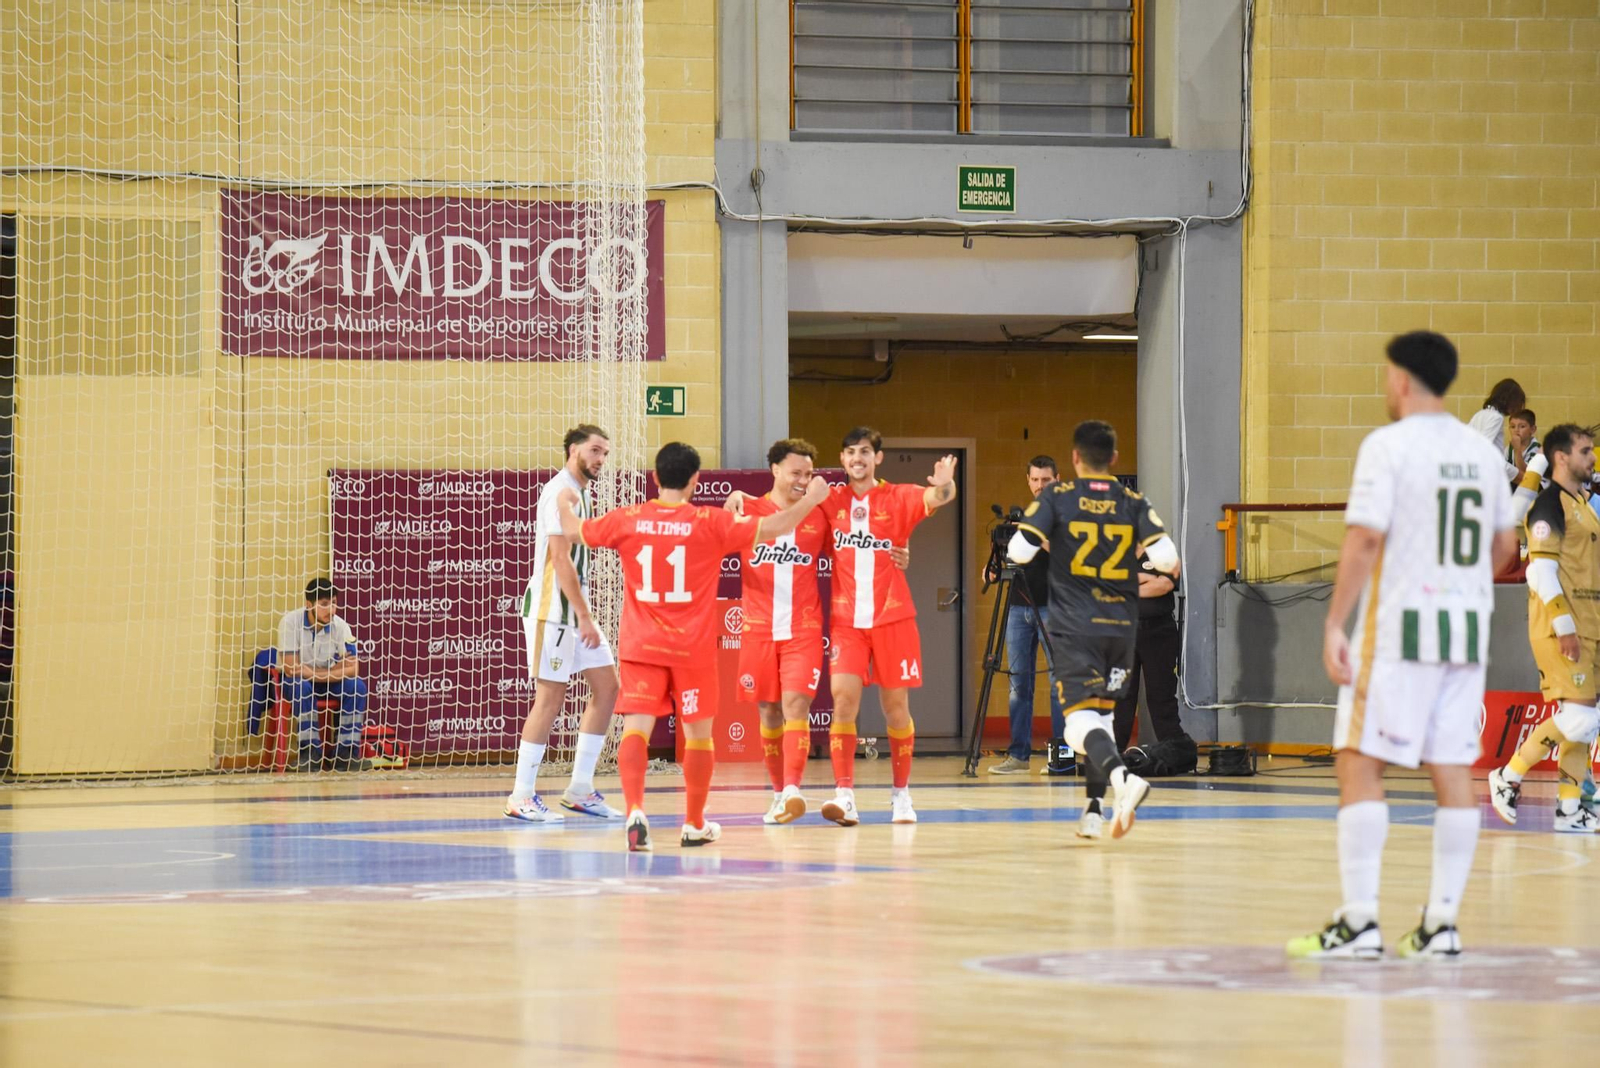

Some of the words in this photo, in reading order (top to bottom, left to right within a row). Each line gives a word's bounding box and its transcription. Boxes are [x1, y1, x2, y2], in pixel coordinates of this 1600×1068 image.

[967, 172, 994, 187] SALIDA
[996, 173, 1006, 188] DE
[962, 190, 1011, 206] EMERGENCIA
[340, 235, 647, 300] IMDECO
[243, 310, 328, 332] Instituto
[333, 313, 431, 337] Municipal
[436, 314, 462, 334] de
[467, 316, 558, 339] Deportes
[436, 481, 495, 495] IMDECO
[393, 520, 452, 534] IMDECO
[635, 519, 692, 537] WALTINHO
[1437, 487, 1483, 567] 16
[751, 541, 811, 565] Jimbee
[1068, 521, 1134, 580] 22
[445, 559, 504, 573] IMDECO
[635, 545, 693, 603] 11
[393, 598, 453, 612] IMDECO
[446, 638, 504, 653] IMDECO
[555, 628, 566, 648] 7
[899, 658, 920, 681] 14
[394, 678, 453, 692] IMDECO
[807, 667, 822, 691] 3
[446, 717, 506, 731] IMDECO
